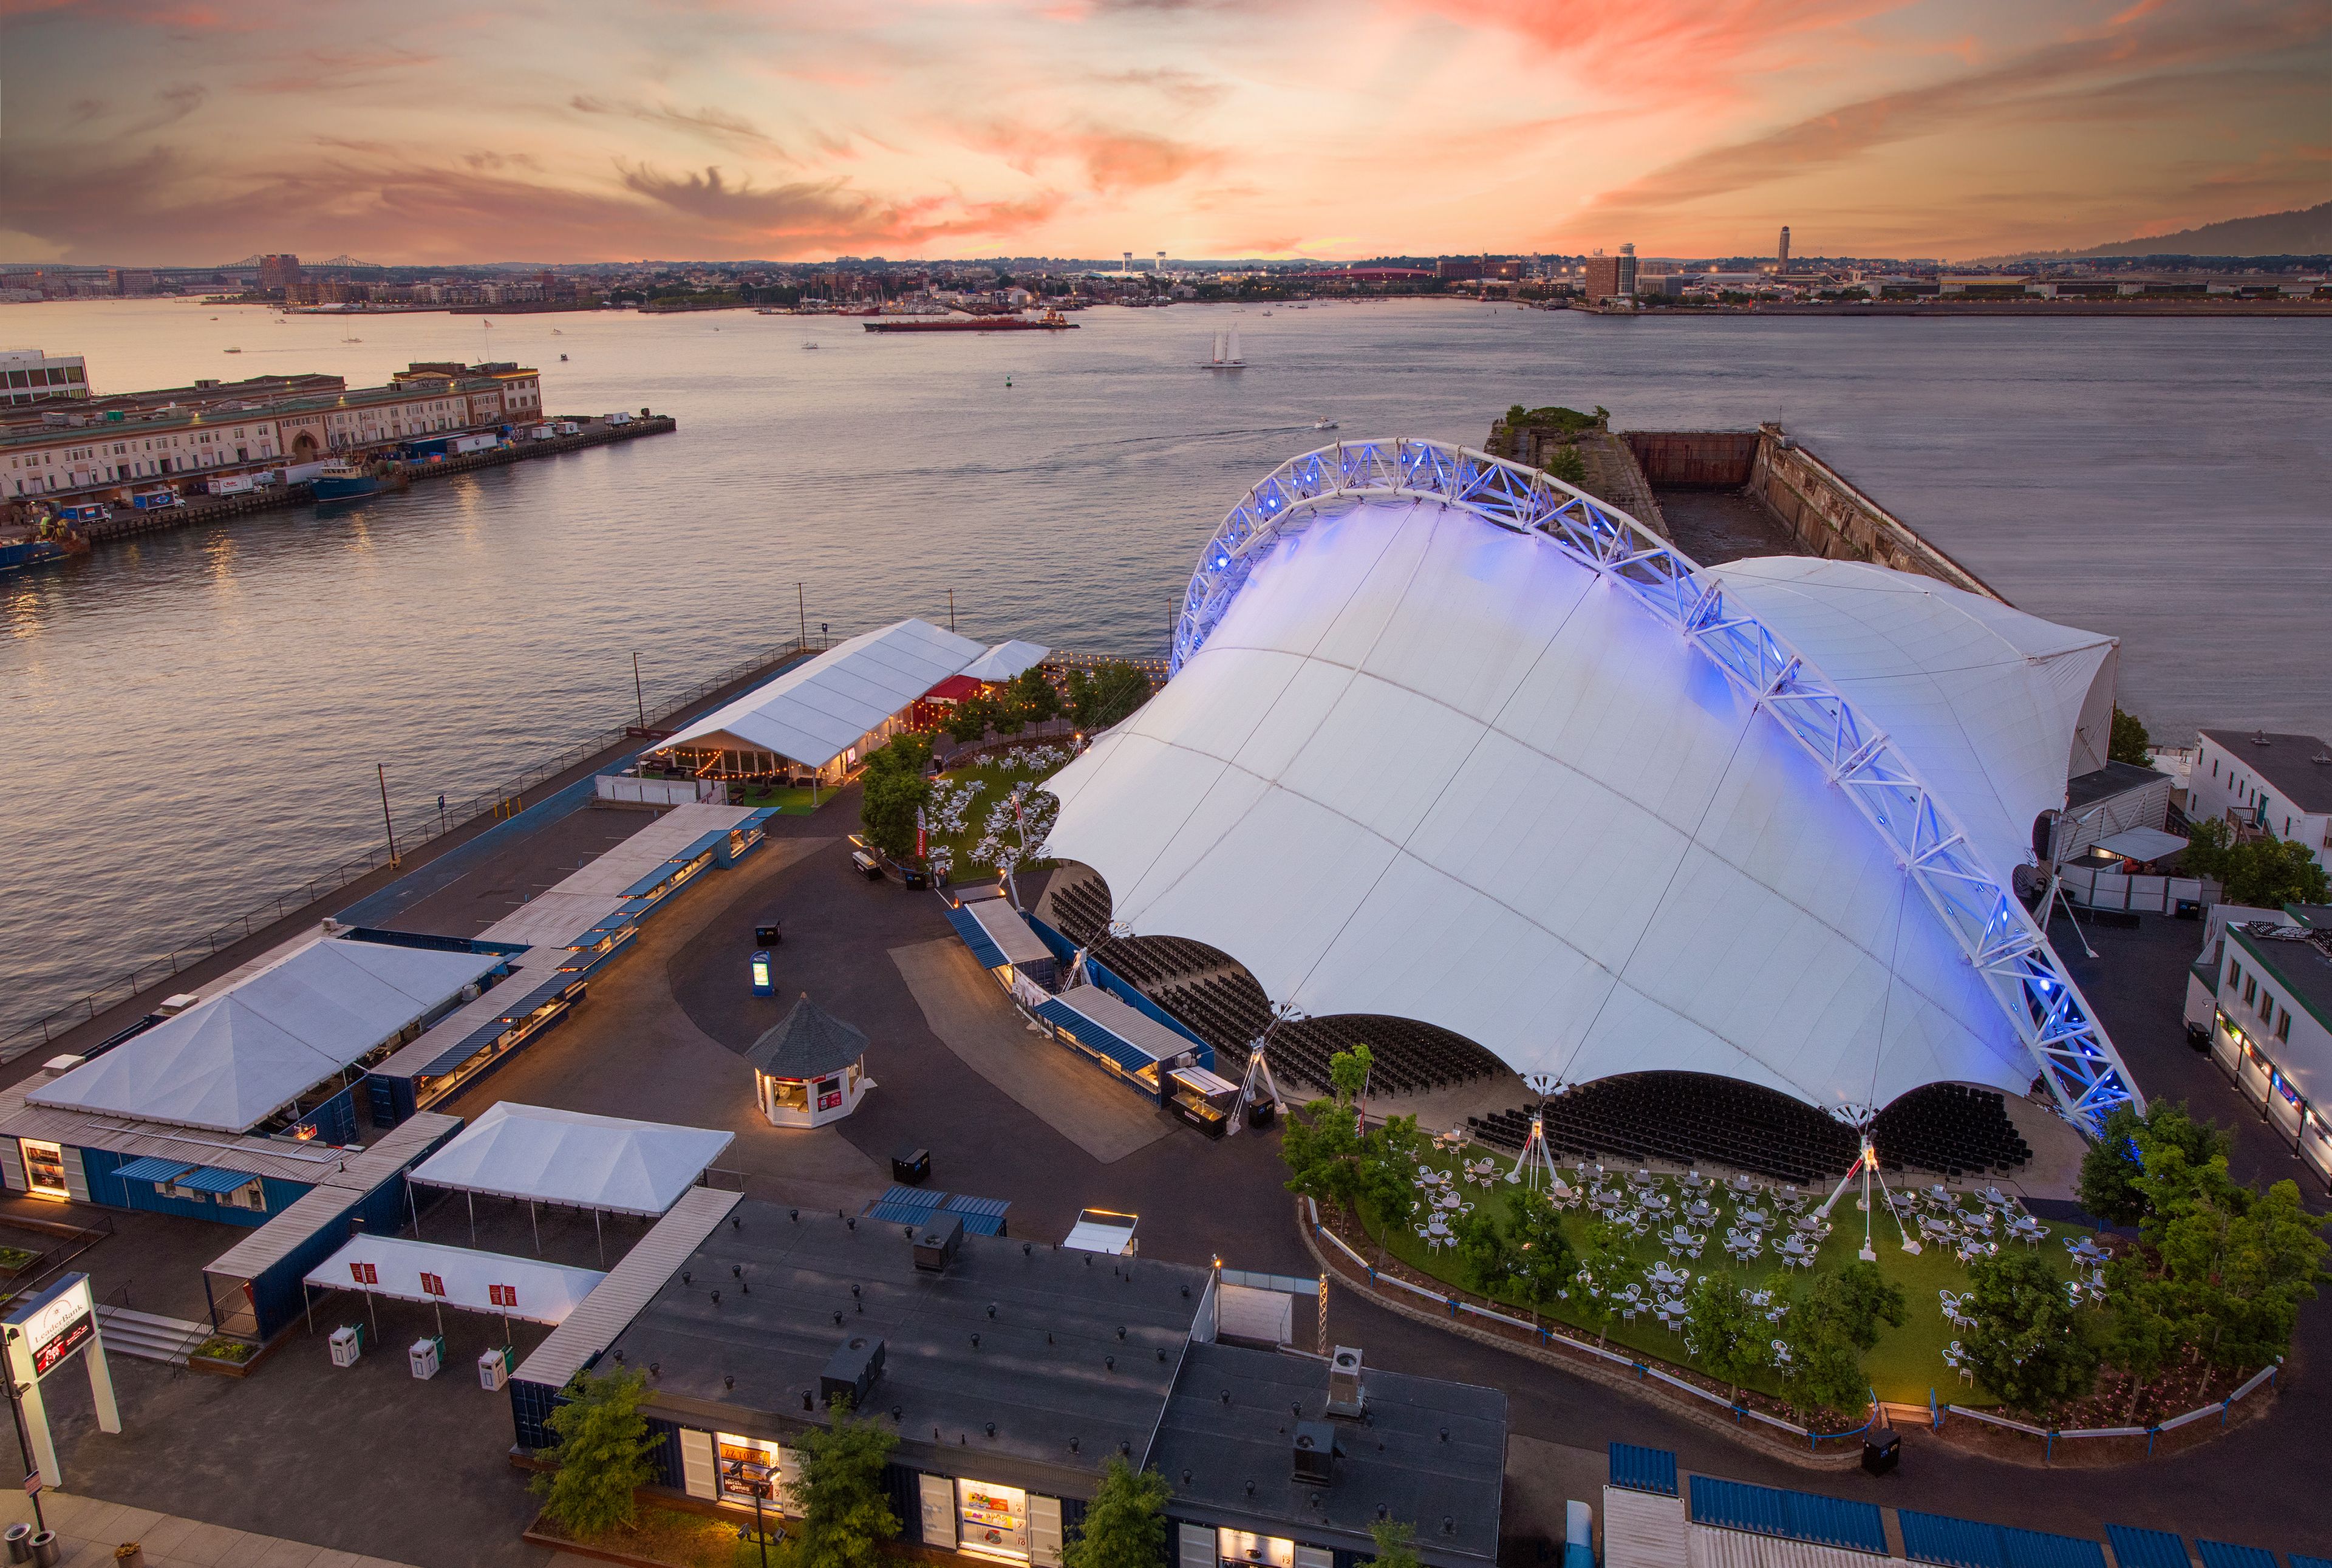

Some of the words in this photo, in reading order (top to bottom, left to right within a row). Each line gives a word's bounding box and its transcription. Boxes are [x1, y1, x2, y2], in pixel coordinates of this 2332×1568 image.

[35, 1304, 83, 1343] LeaderBank
[46, 1318, 75, 1340] PAVILION
[724, 1448, 736, 1457] ZZ
[738, 1451, 755, 1460] TOP
